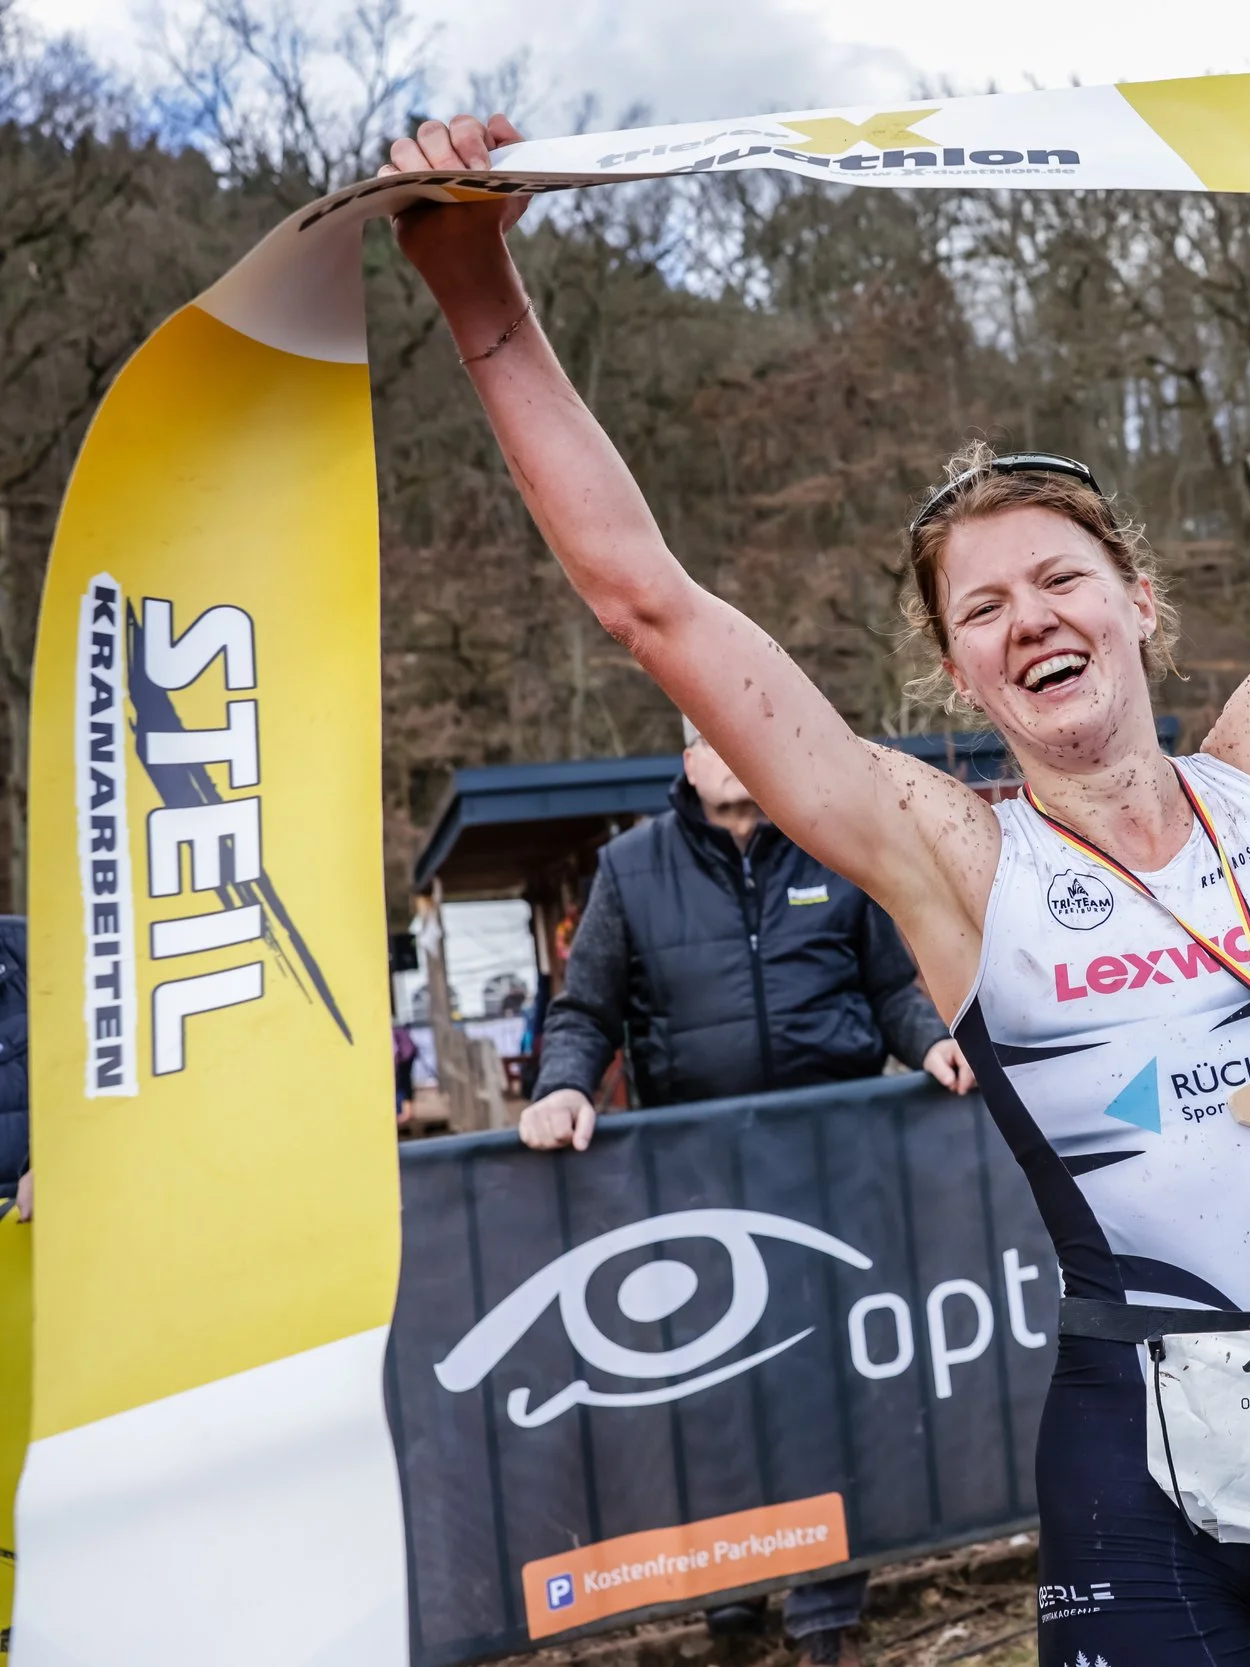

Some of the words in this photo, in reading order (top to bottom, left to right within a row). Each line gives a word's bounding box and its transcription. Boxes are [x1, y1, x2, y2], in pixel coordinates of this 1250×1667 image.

[597, 129, 789, 168] trierer
[664, 146, 1081, 173] duathlon
[89, 585, 124, 1089] KRANARBEITEN
[141, 596, 264, 1077] STEIL
[1051, 897, 1111, 909] TRI-TEAM
[1182, 1102, 1228, 1123] Spor
[583, 1548, 710, 1594] Kostenfreie
[713, 1524, 828, 1564] Parkplätze
